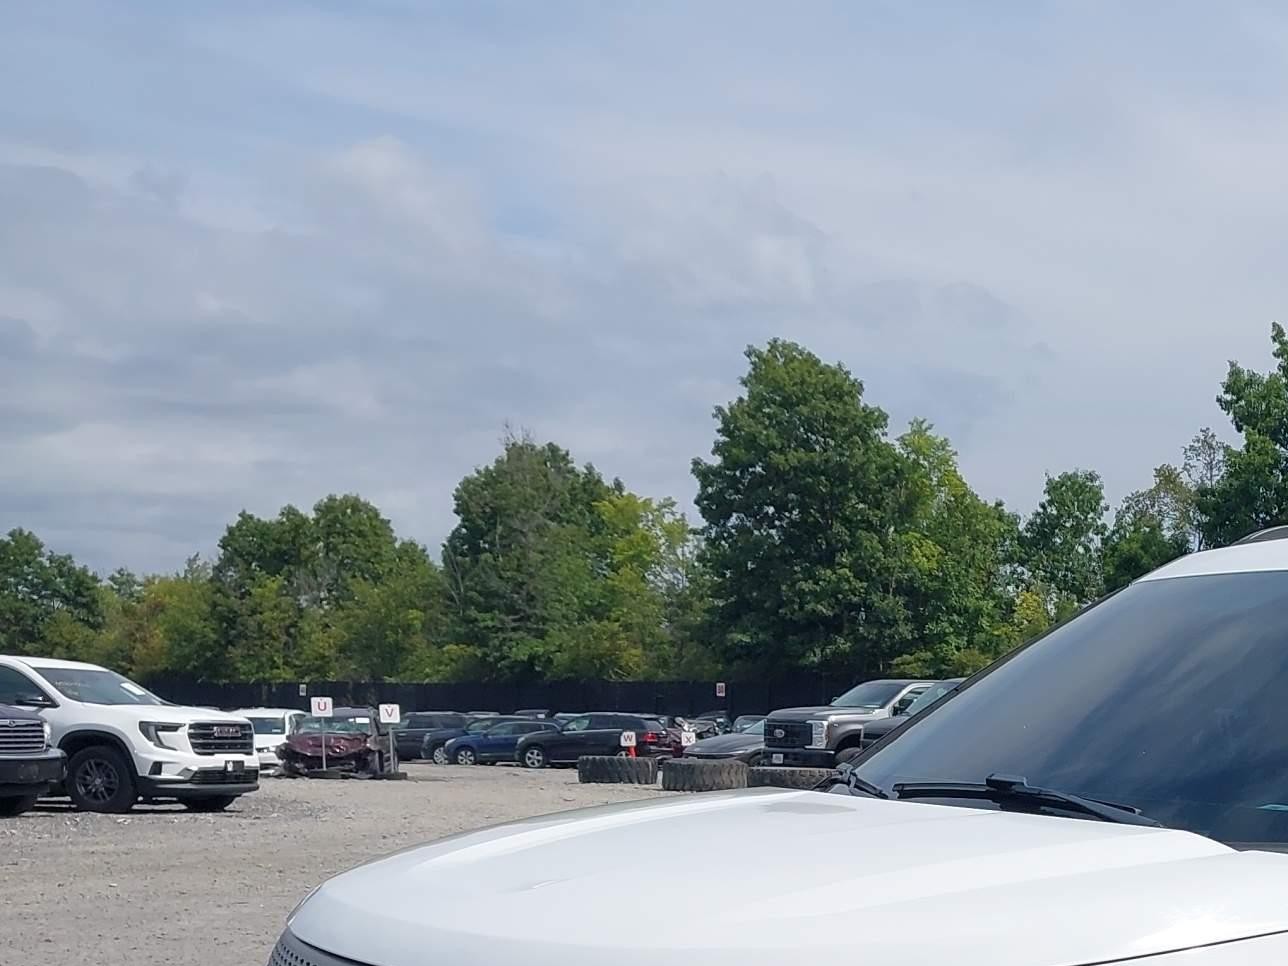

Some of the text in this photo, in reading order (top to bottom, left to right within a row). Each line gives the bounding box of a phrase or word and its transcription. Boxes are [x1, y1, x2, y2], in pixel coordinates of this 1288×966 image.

[317, 702, 327, 712] U
[385, 708, 394, 717] V
[623, 734, 633, 742] W
